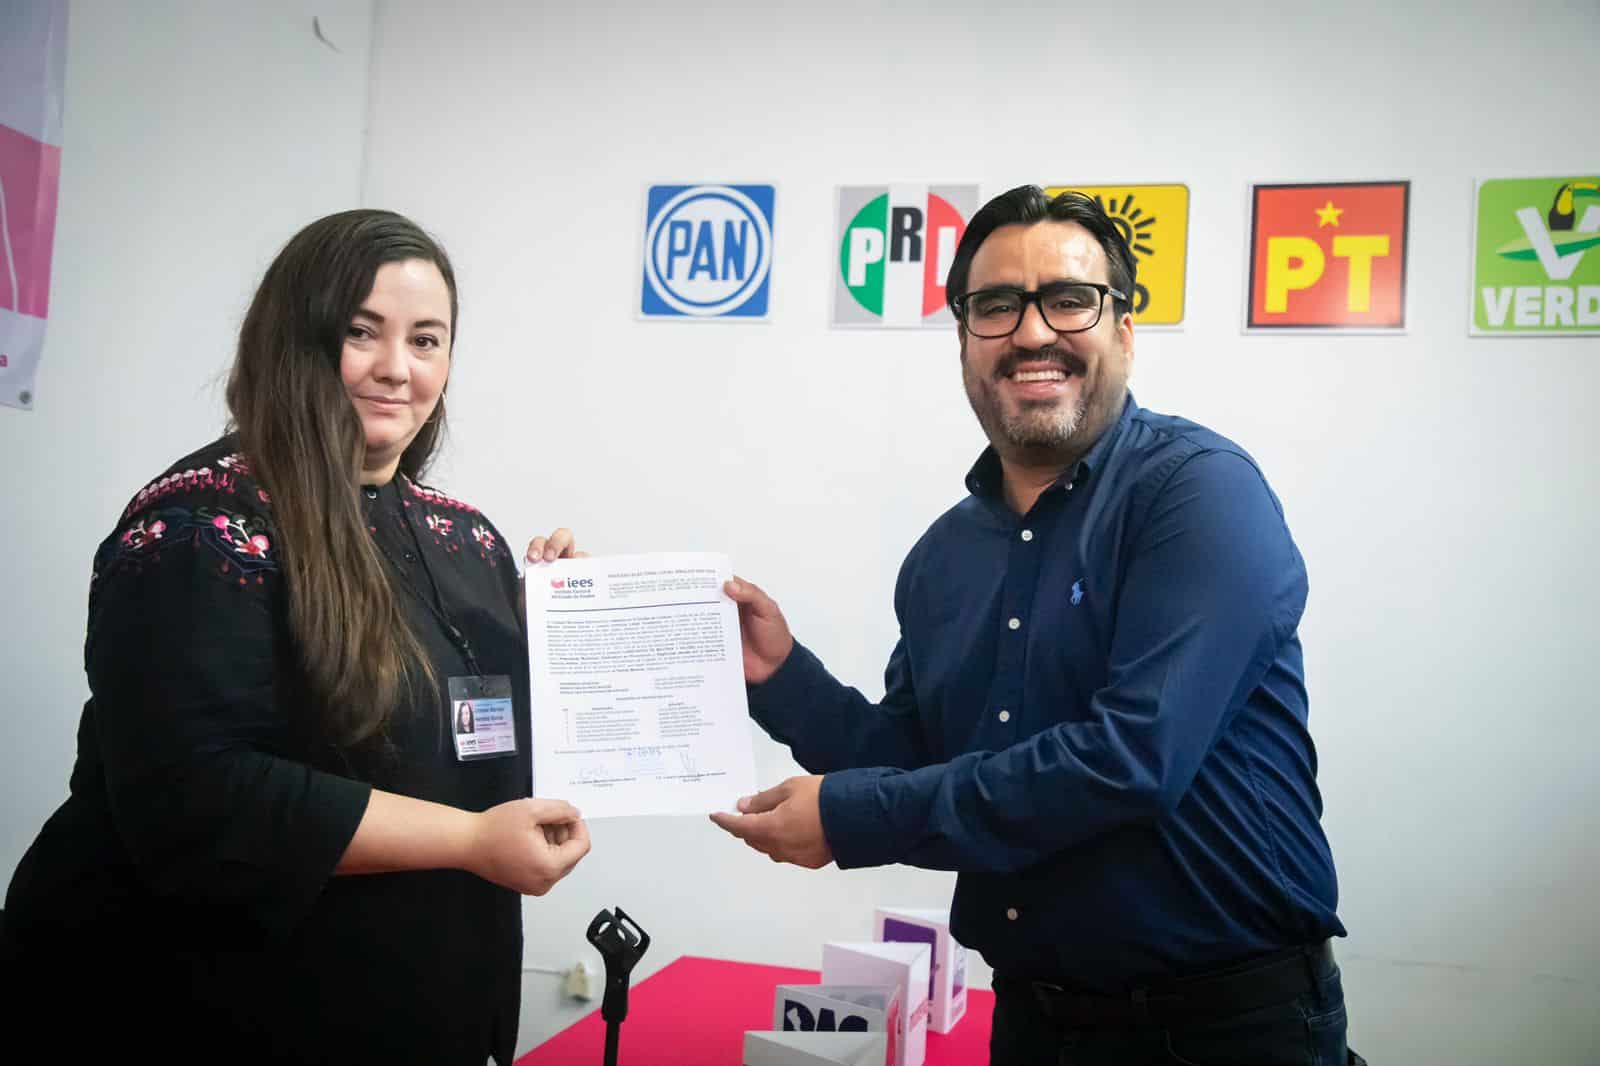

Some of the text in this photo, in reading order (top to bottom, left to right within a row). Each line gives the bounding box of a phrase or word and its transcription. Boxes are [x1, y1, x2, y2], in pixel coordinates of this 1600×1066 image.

[666, 220, 748, 281] PAN
[849, 207, 957, 287] PRI
[1264, 234, 1390, 313] PT
[1481, 285, 1600, 327] VERD
[567, 577, 594, 588] iees
